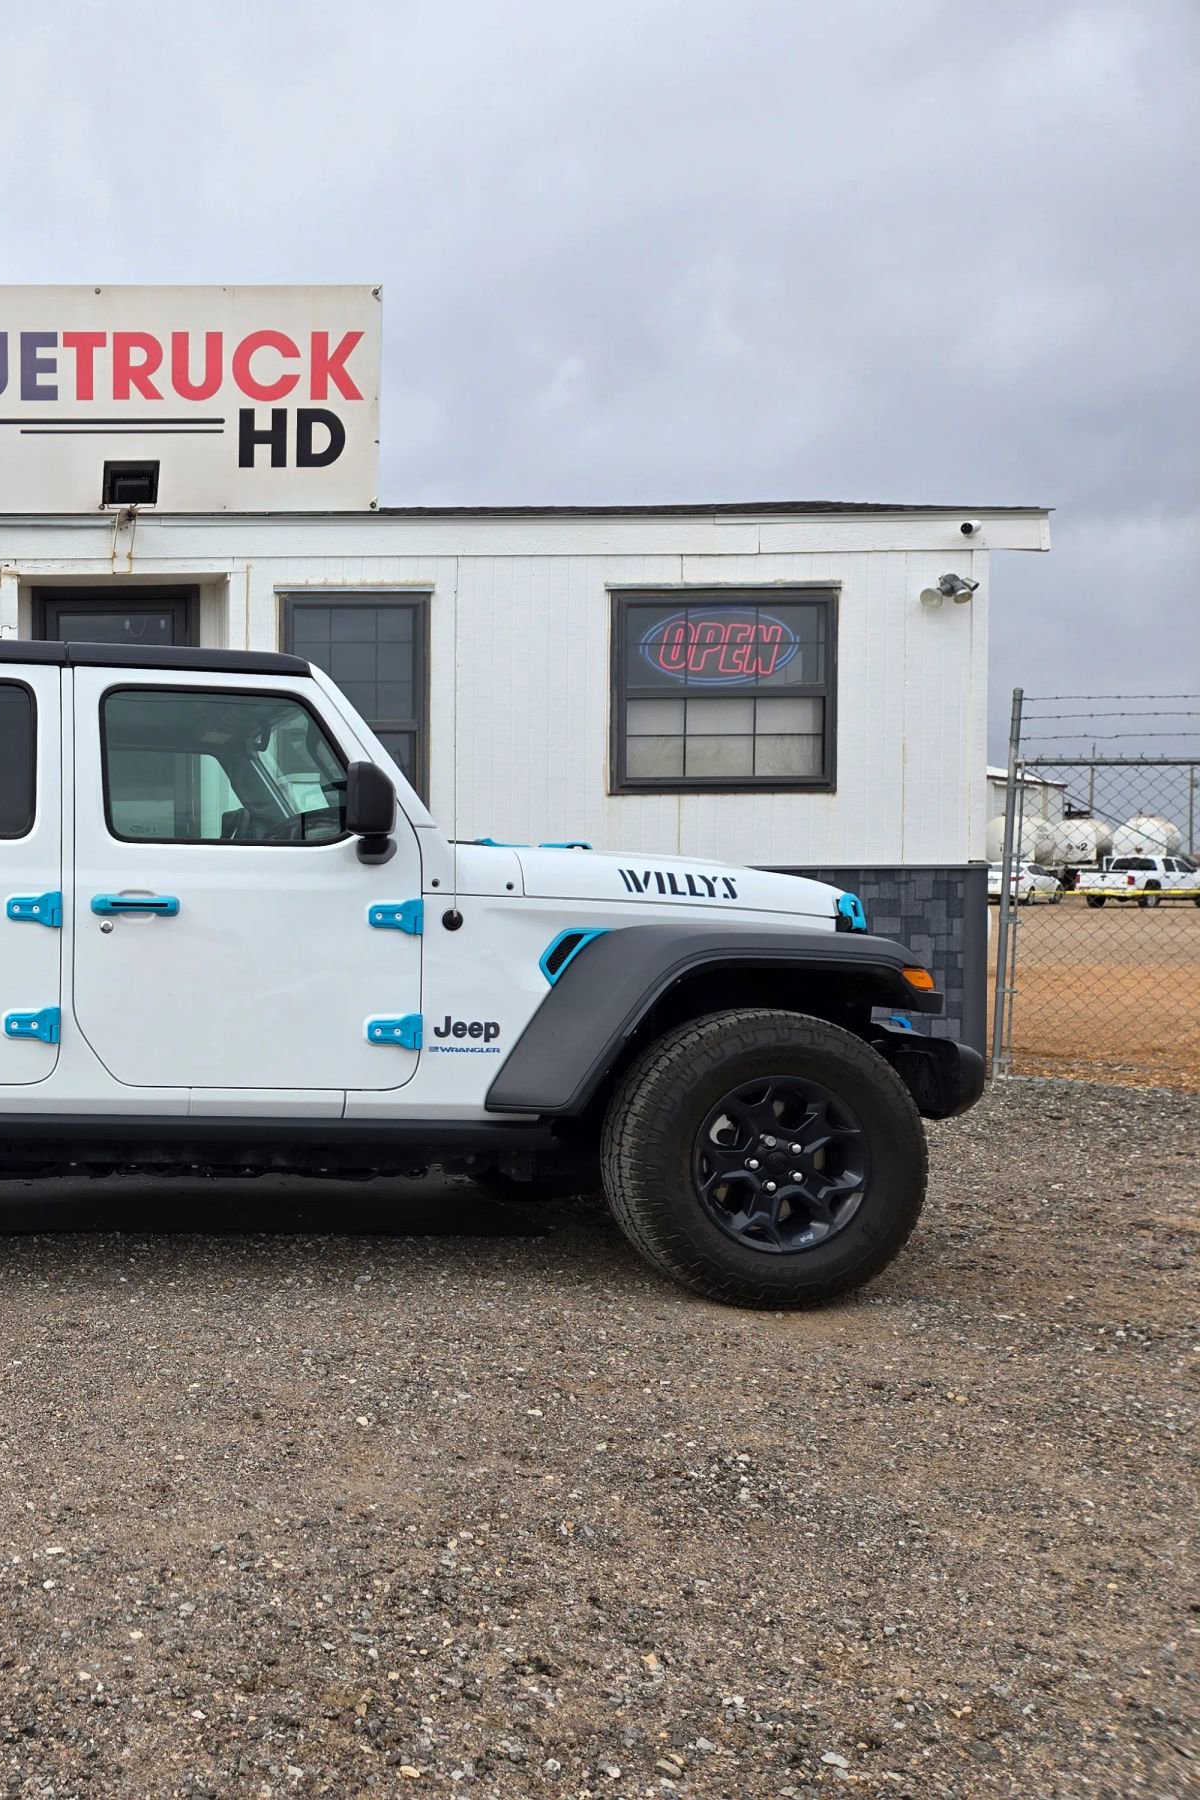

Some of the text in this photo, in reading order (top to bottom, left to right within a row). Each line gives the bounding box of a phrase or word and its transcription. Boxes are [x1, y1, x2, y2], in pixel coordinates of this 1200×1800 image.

[238, 408, 346, 469] HD
[658, 620, 783, 677] OPEN
[617, 868, 738, 900] WILLYS
[433, 1015, 501, 1043] Jeep
[439, 1046, 501, 1054] WRANGLER
